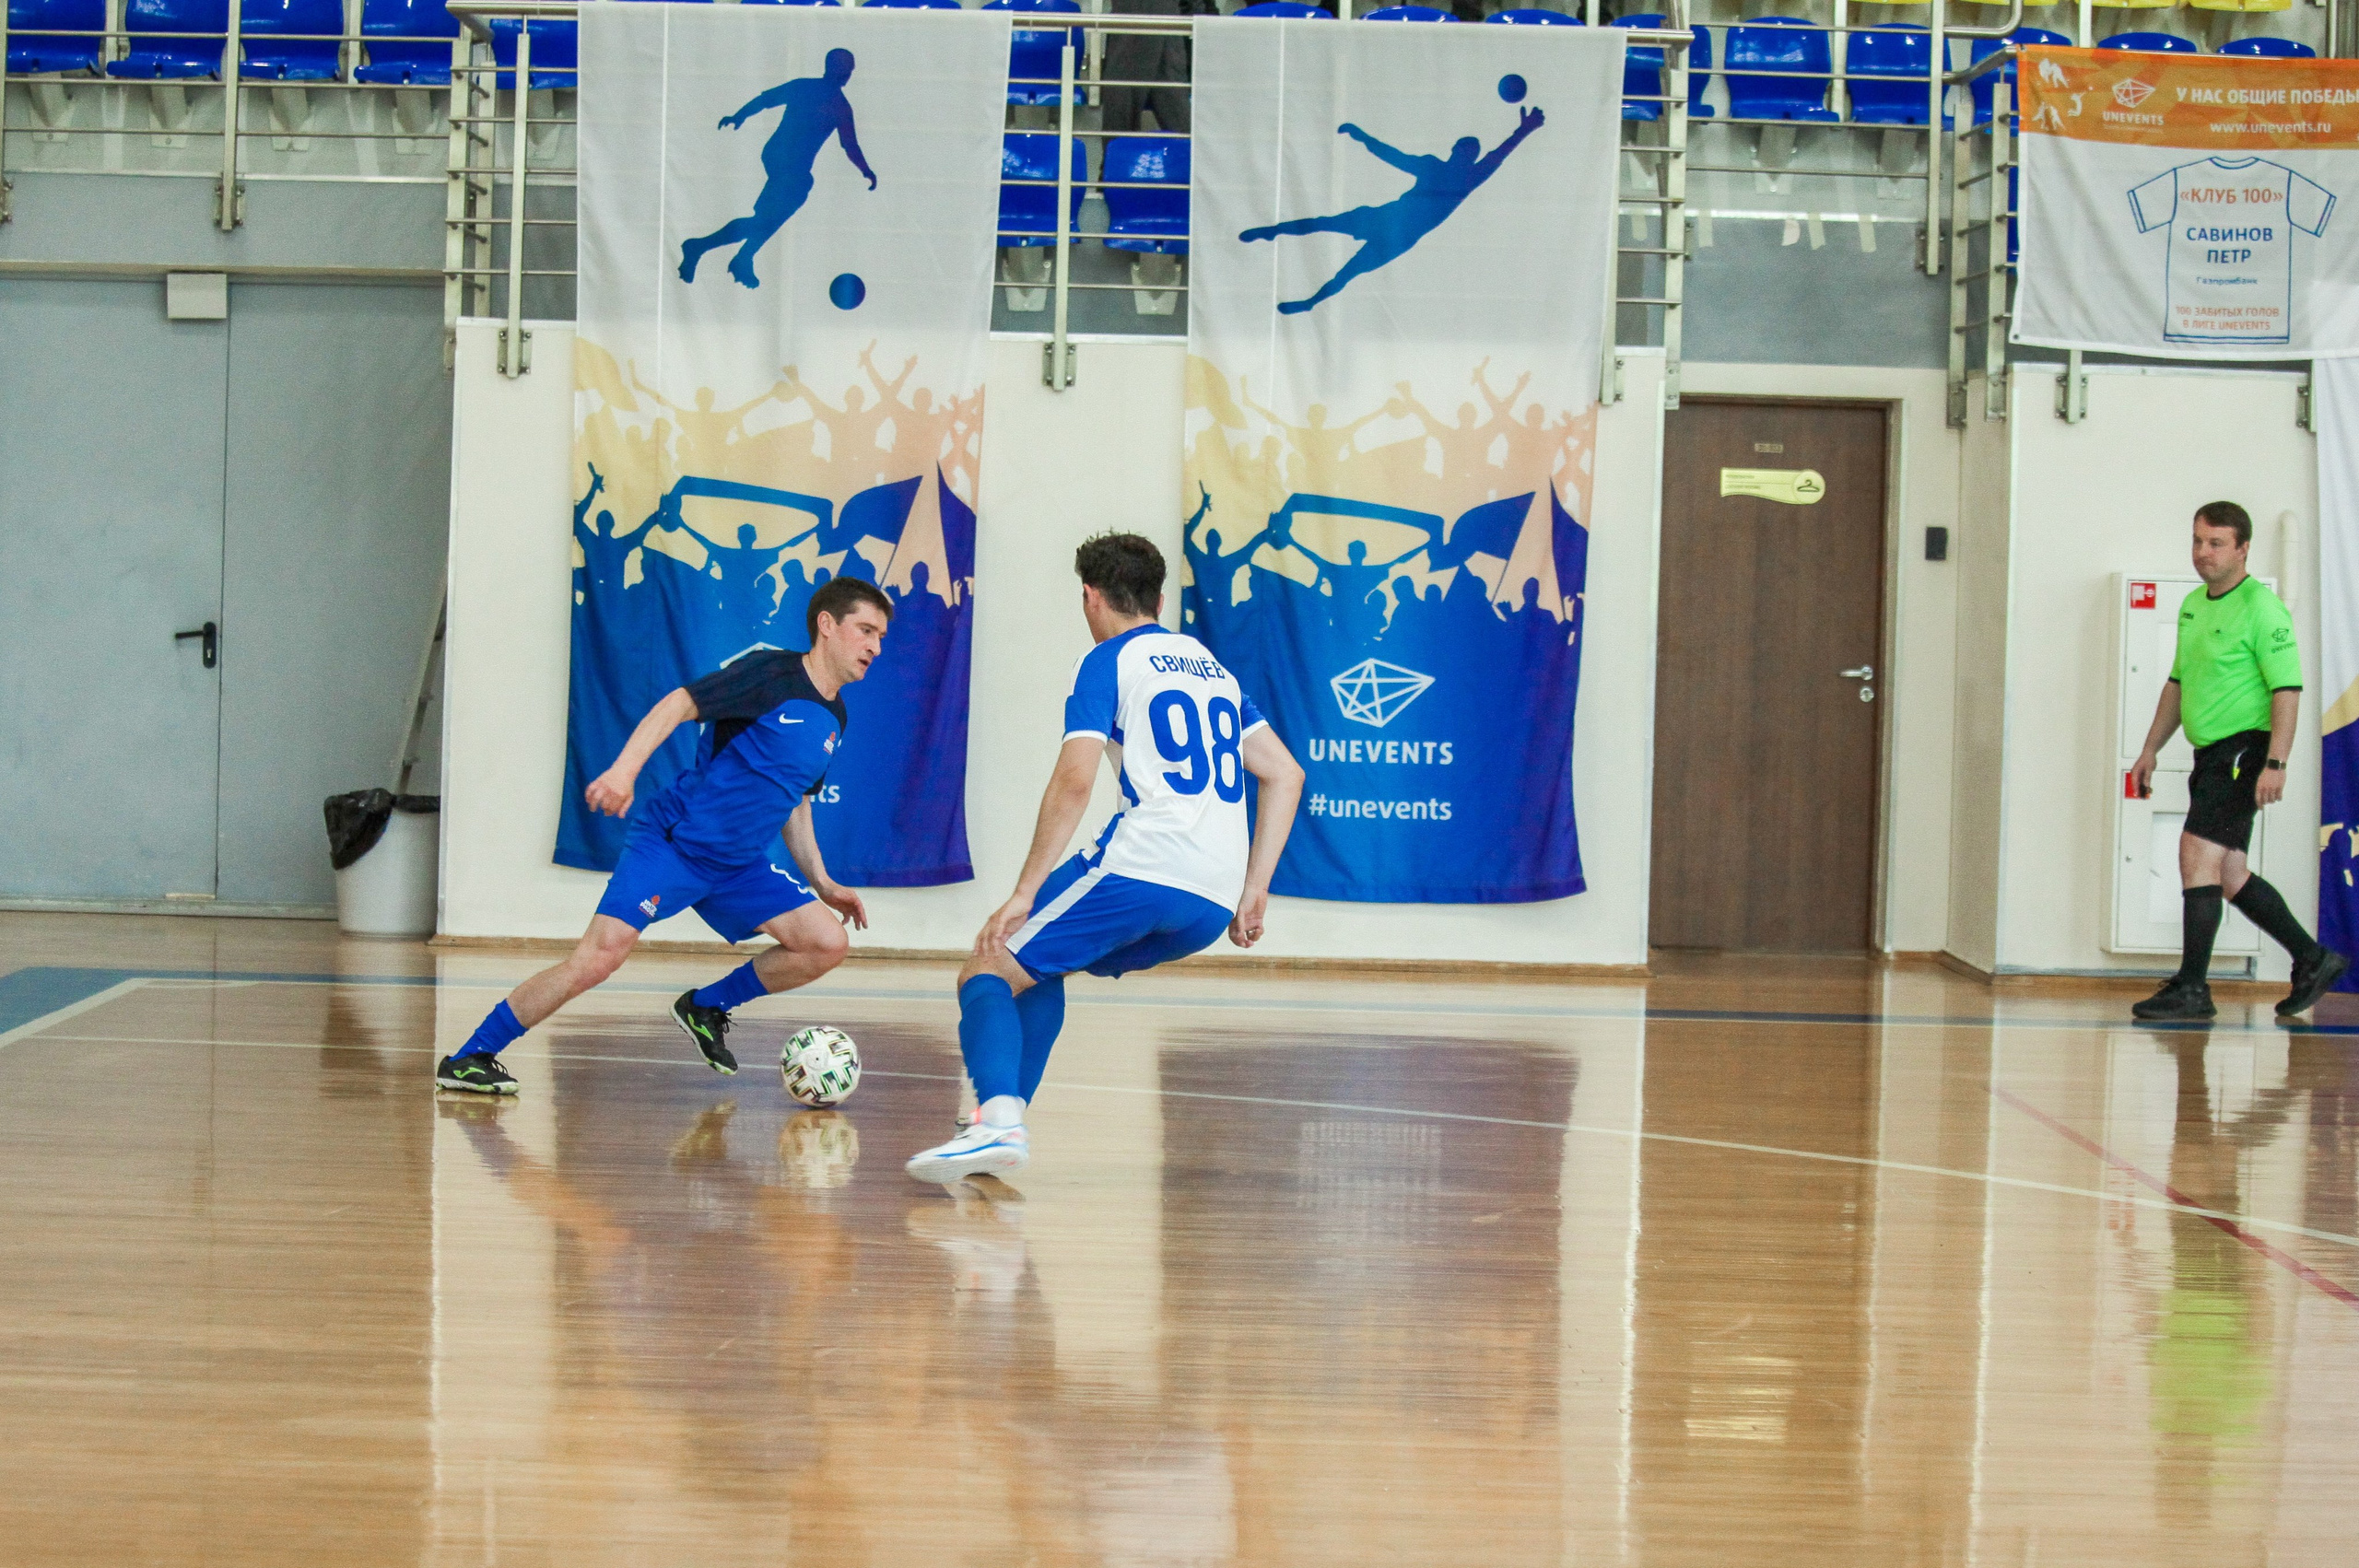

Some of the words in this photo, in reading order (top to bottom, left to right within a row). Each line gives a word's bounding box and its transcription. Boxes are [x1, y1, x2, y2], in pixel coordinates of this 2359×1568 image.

[2176, 87, 2189, 102] У
[2190, 88, 2224, 104] НАС
[2227, 89, 2286, 106] ОБЩИЕ
[2290, 89, 2359, 106] ПОБЕДЫ
[2102, 111, 2165, 126] UNEVENTS
[2210, 122, 2331, 134] www.unevents.ru
[2179, 188, 2237, 204] «КЛУБ
[2242, 188, 2283, 204] 100»
[2186, 227, 2273, 241] САВИНОВ
[2206, 249, 2251, 263] ПЕТР
[2194, 307, 2243, 317] ЗАБИТЫХ
[2246, 308, 2281, 317] ГОЛОВ
[2192, 320, 2216, 330] ЛИГЕ
[2218, 321, 2271, 331] UNEVENTS
[1149, 655, 1226, 682] СВИЩЁВ
[1148, 689, 1245, 803] 98
[1309, 738, 1454, 766] UNEVENTS
[1308, 793, 1453, 821] #unevents
